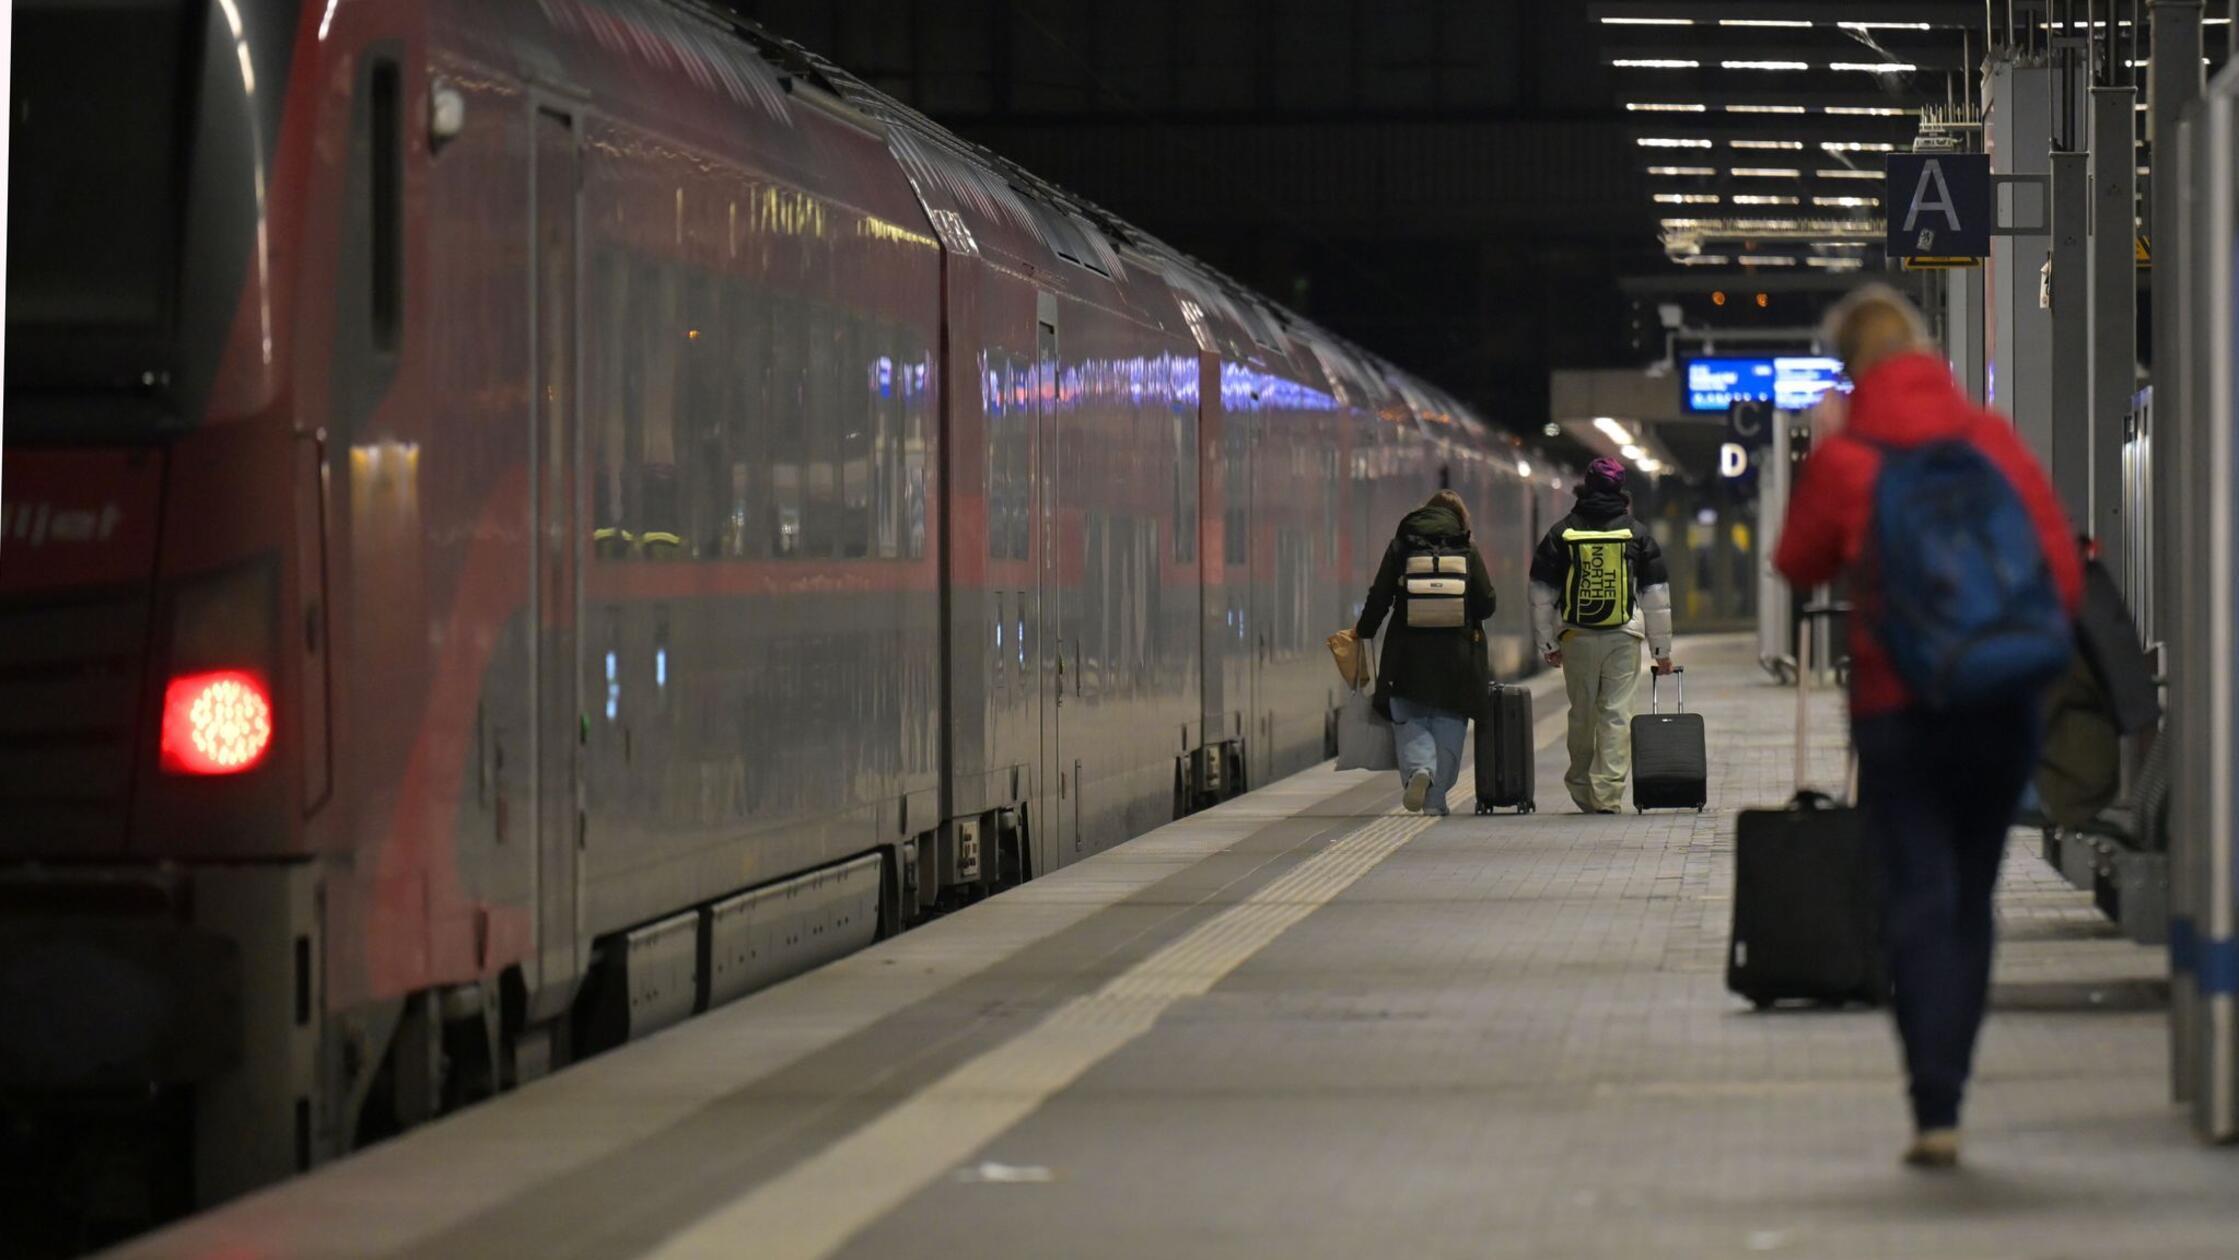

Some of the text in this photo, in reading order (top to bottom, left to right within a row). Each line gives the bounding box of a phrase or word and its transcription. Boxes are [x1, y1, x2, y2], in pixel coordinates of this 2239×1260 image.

[1903, 158, 1961, 231] A
[1733, 400, 1762, 436] C
[1720, 443, 1747, 477] D
[1580, 561, 1591, 598] FACE
[1591, 546, 1604, 598] NORTH
[1604, 569, 1616, 598] THE
